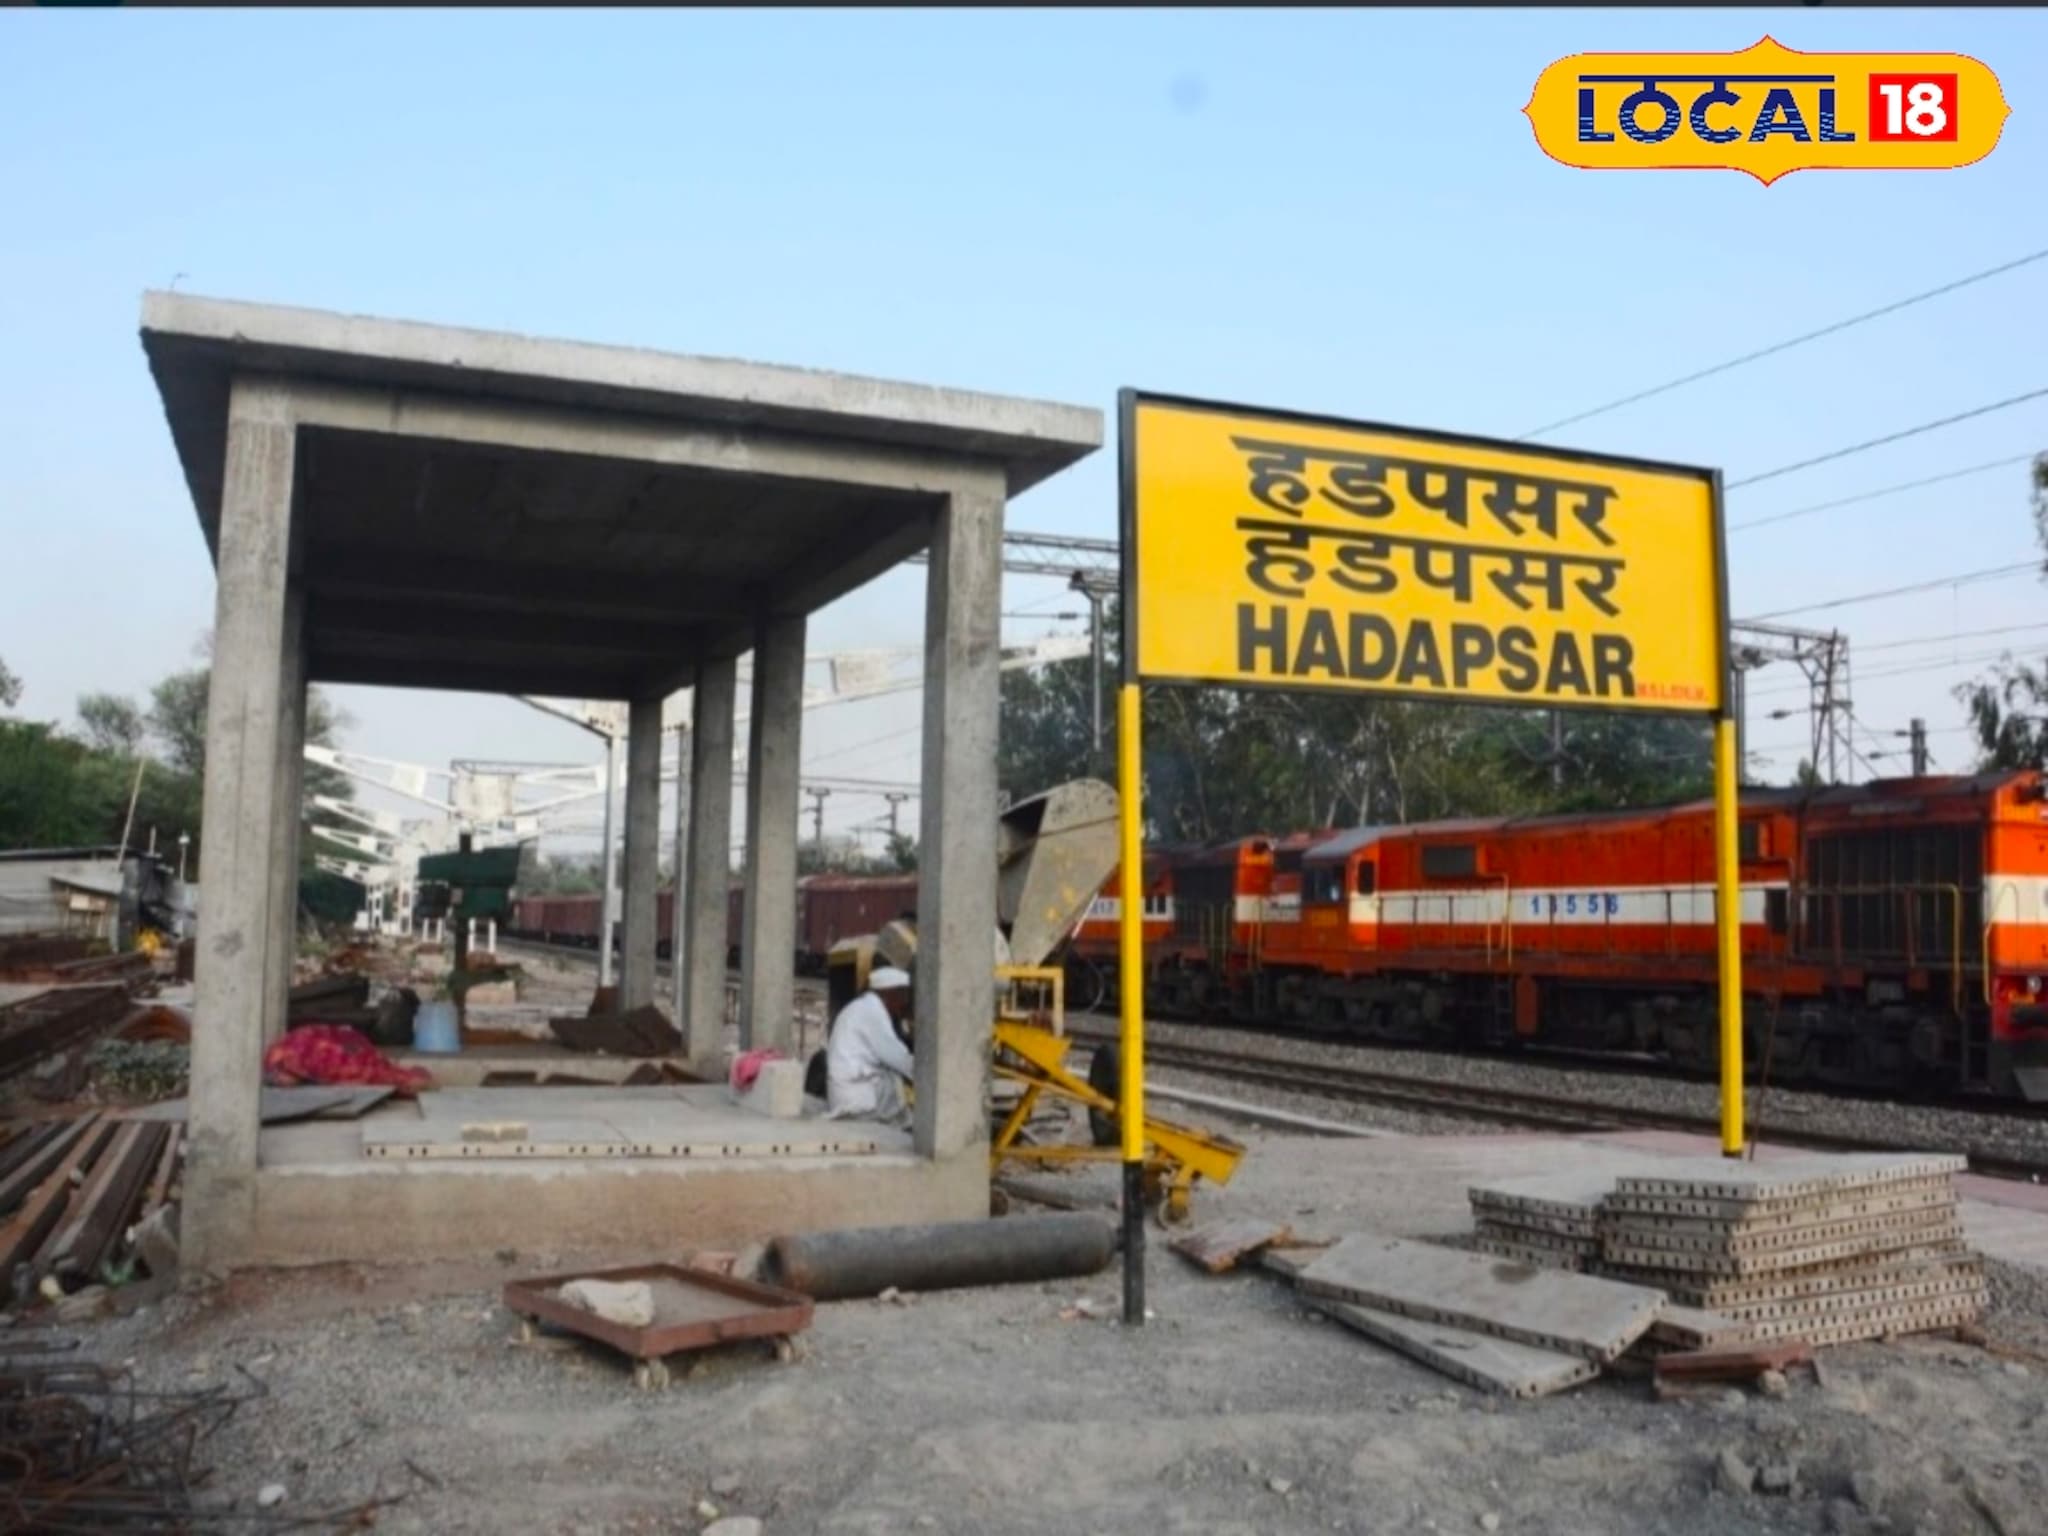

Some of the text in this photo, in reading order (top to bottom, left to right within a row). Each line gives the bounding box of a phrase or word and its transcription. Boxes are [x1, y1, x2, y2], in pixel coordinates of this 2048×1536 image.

[1230, 436, 1619, 546] हडपसर
[1236, 517, 1625, 617] हडपसर
[1237, 603, 1636, 698] HADAPSAR
